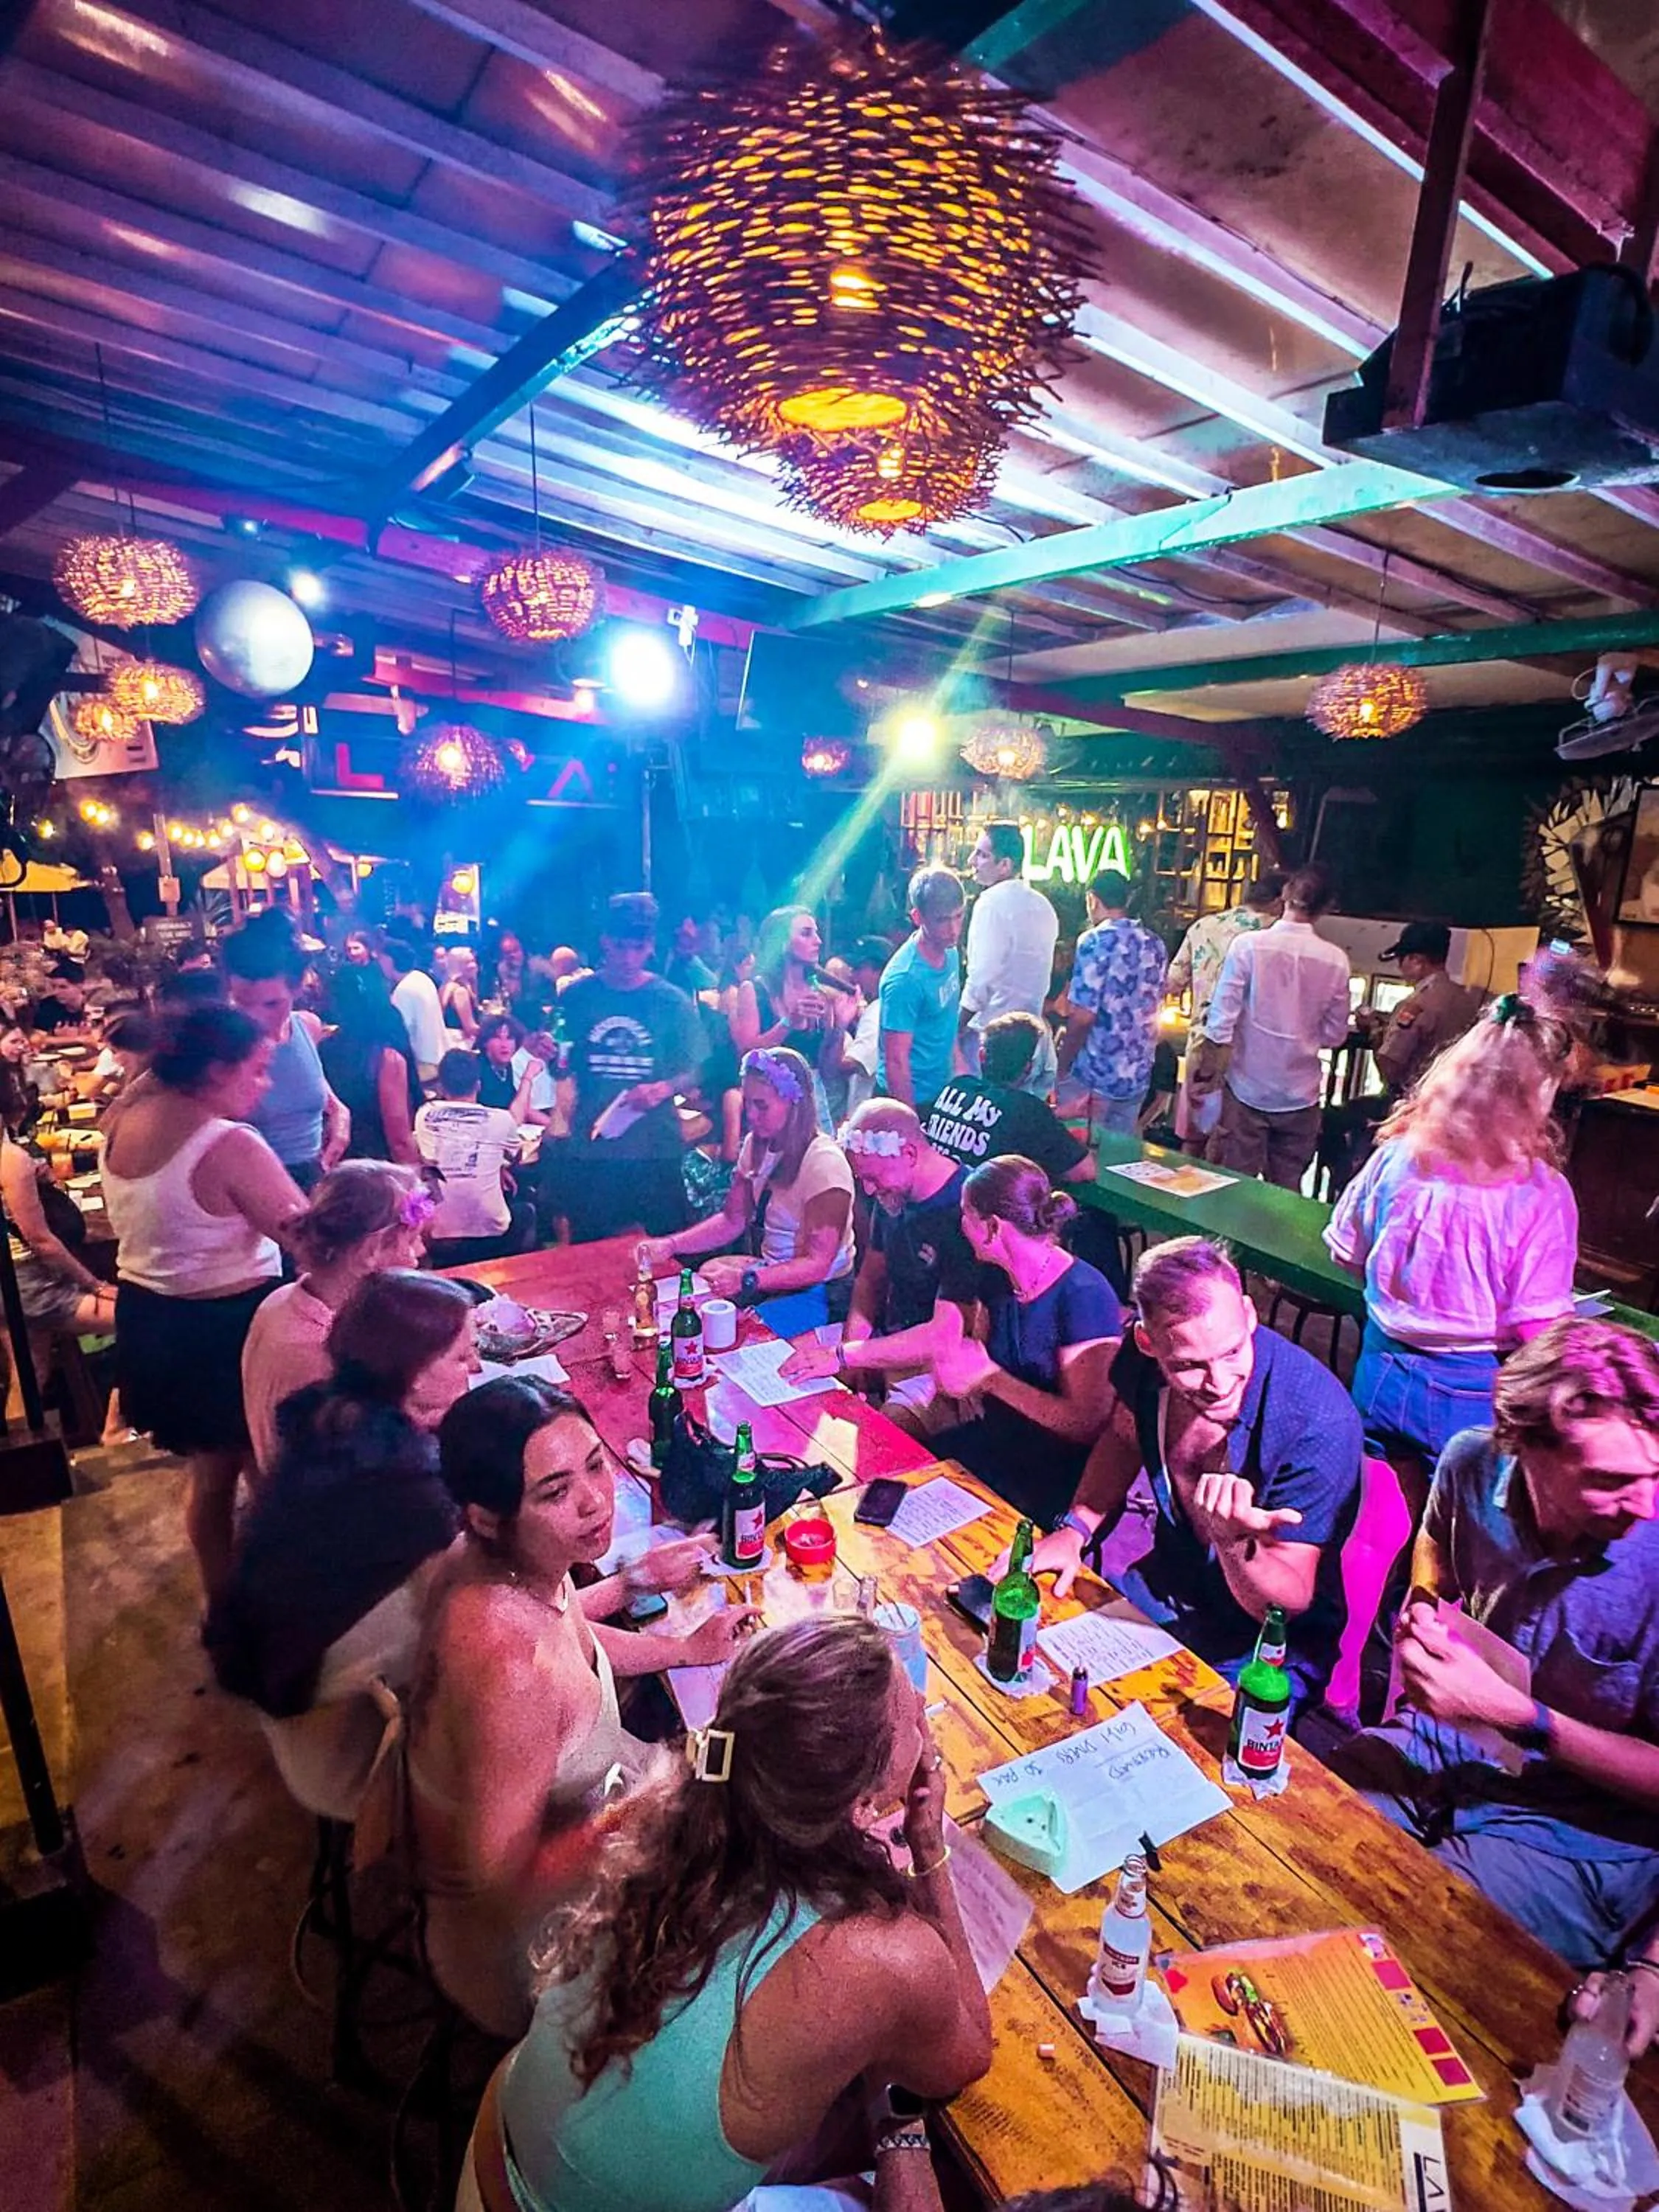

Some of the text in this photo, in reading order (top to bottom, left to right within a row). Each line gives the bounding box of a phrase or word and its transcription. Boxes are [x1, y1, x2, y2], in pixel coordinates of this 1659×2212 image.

[1022, 824, 1131, 883] LAVA
[933, 1085, 967, 1116] ALL
[919, 1114, 990, 1156] RIENDS
